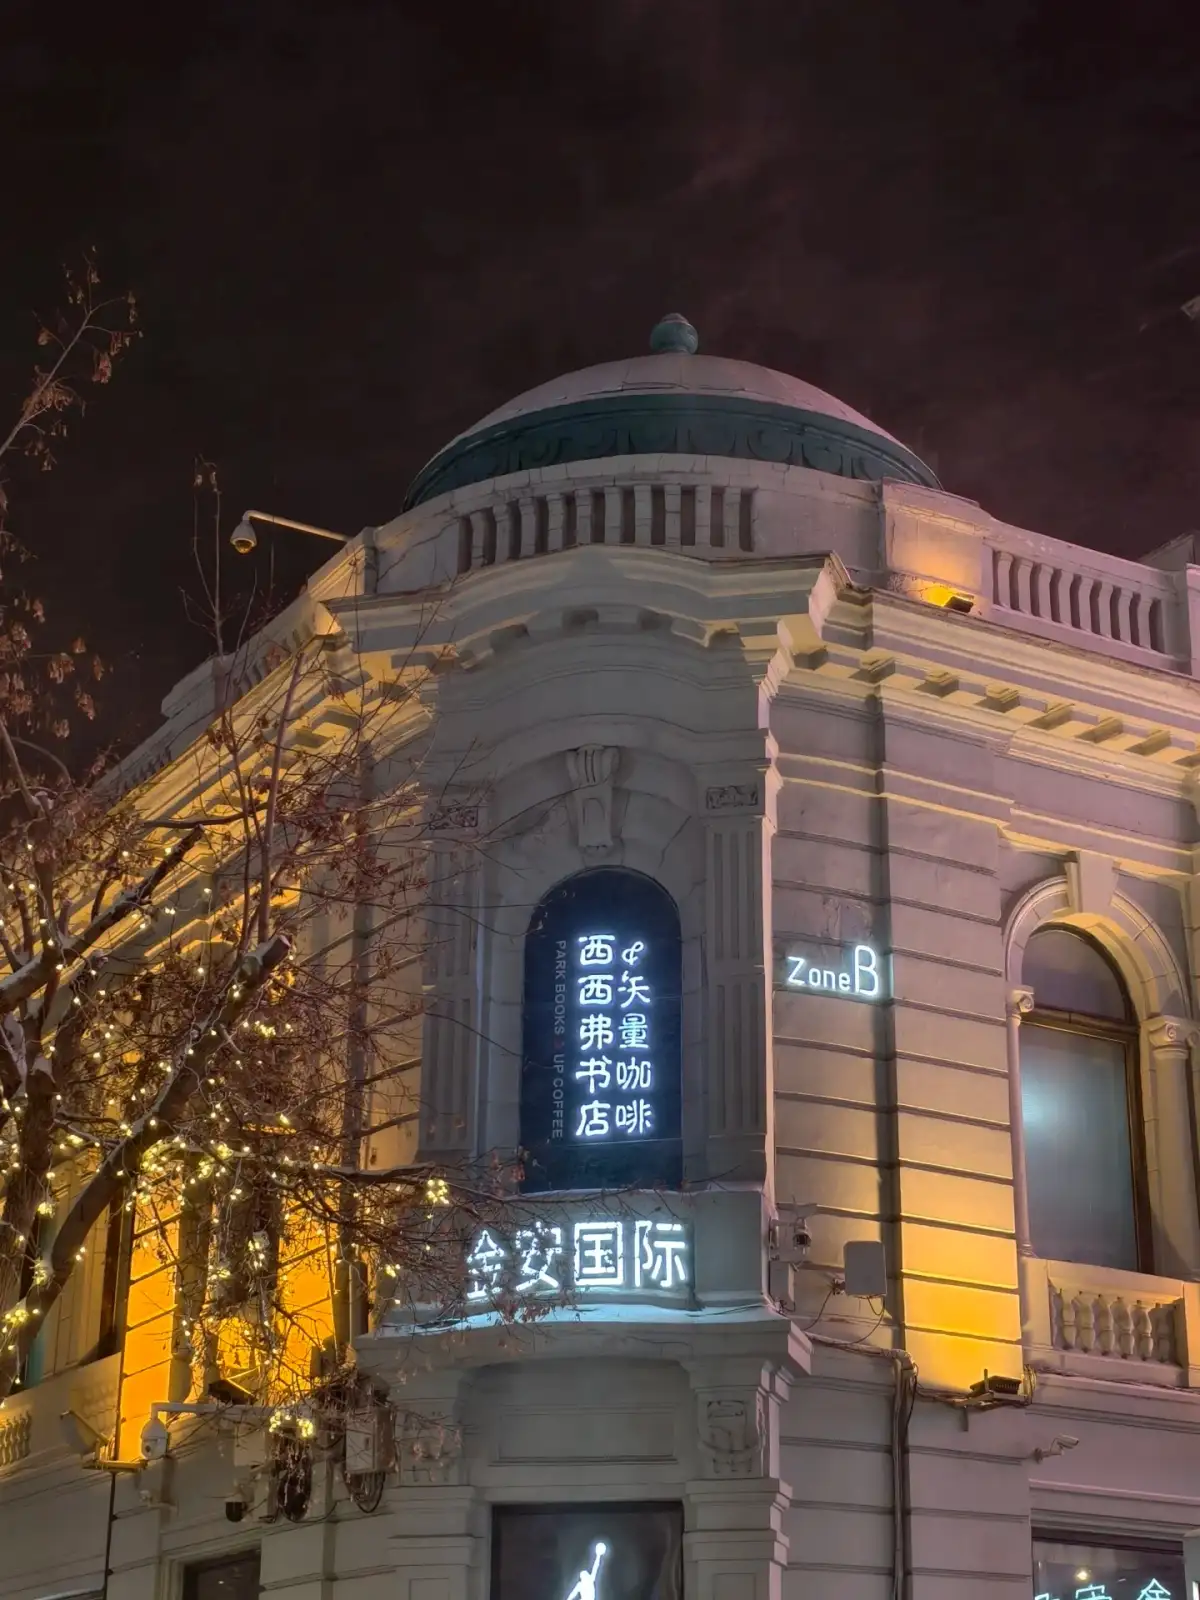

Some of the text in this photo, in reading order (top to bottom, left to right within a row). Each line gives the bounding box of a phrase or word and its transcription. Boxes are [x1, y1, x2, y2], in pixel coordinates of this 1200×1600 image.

[552, 940, 567, 1138] PARK BOOKS UP COFFEE
[575, 934, 616, 1137] 西西弗书店
[466, 1219, 687, 1299] 金安国际
